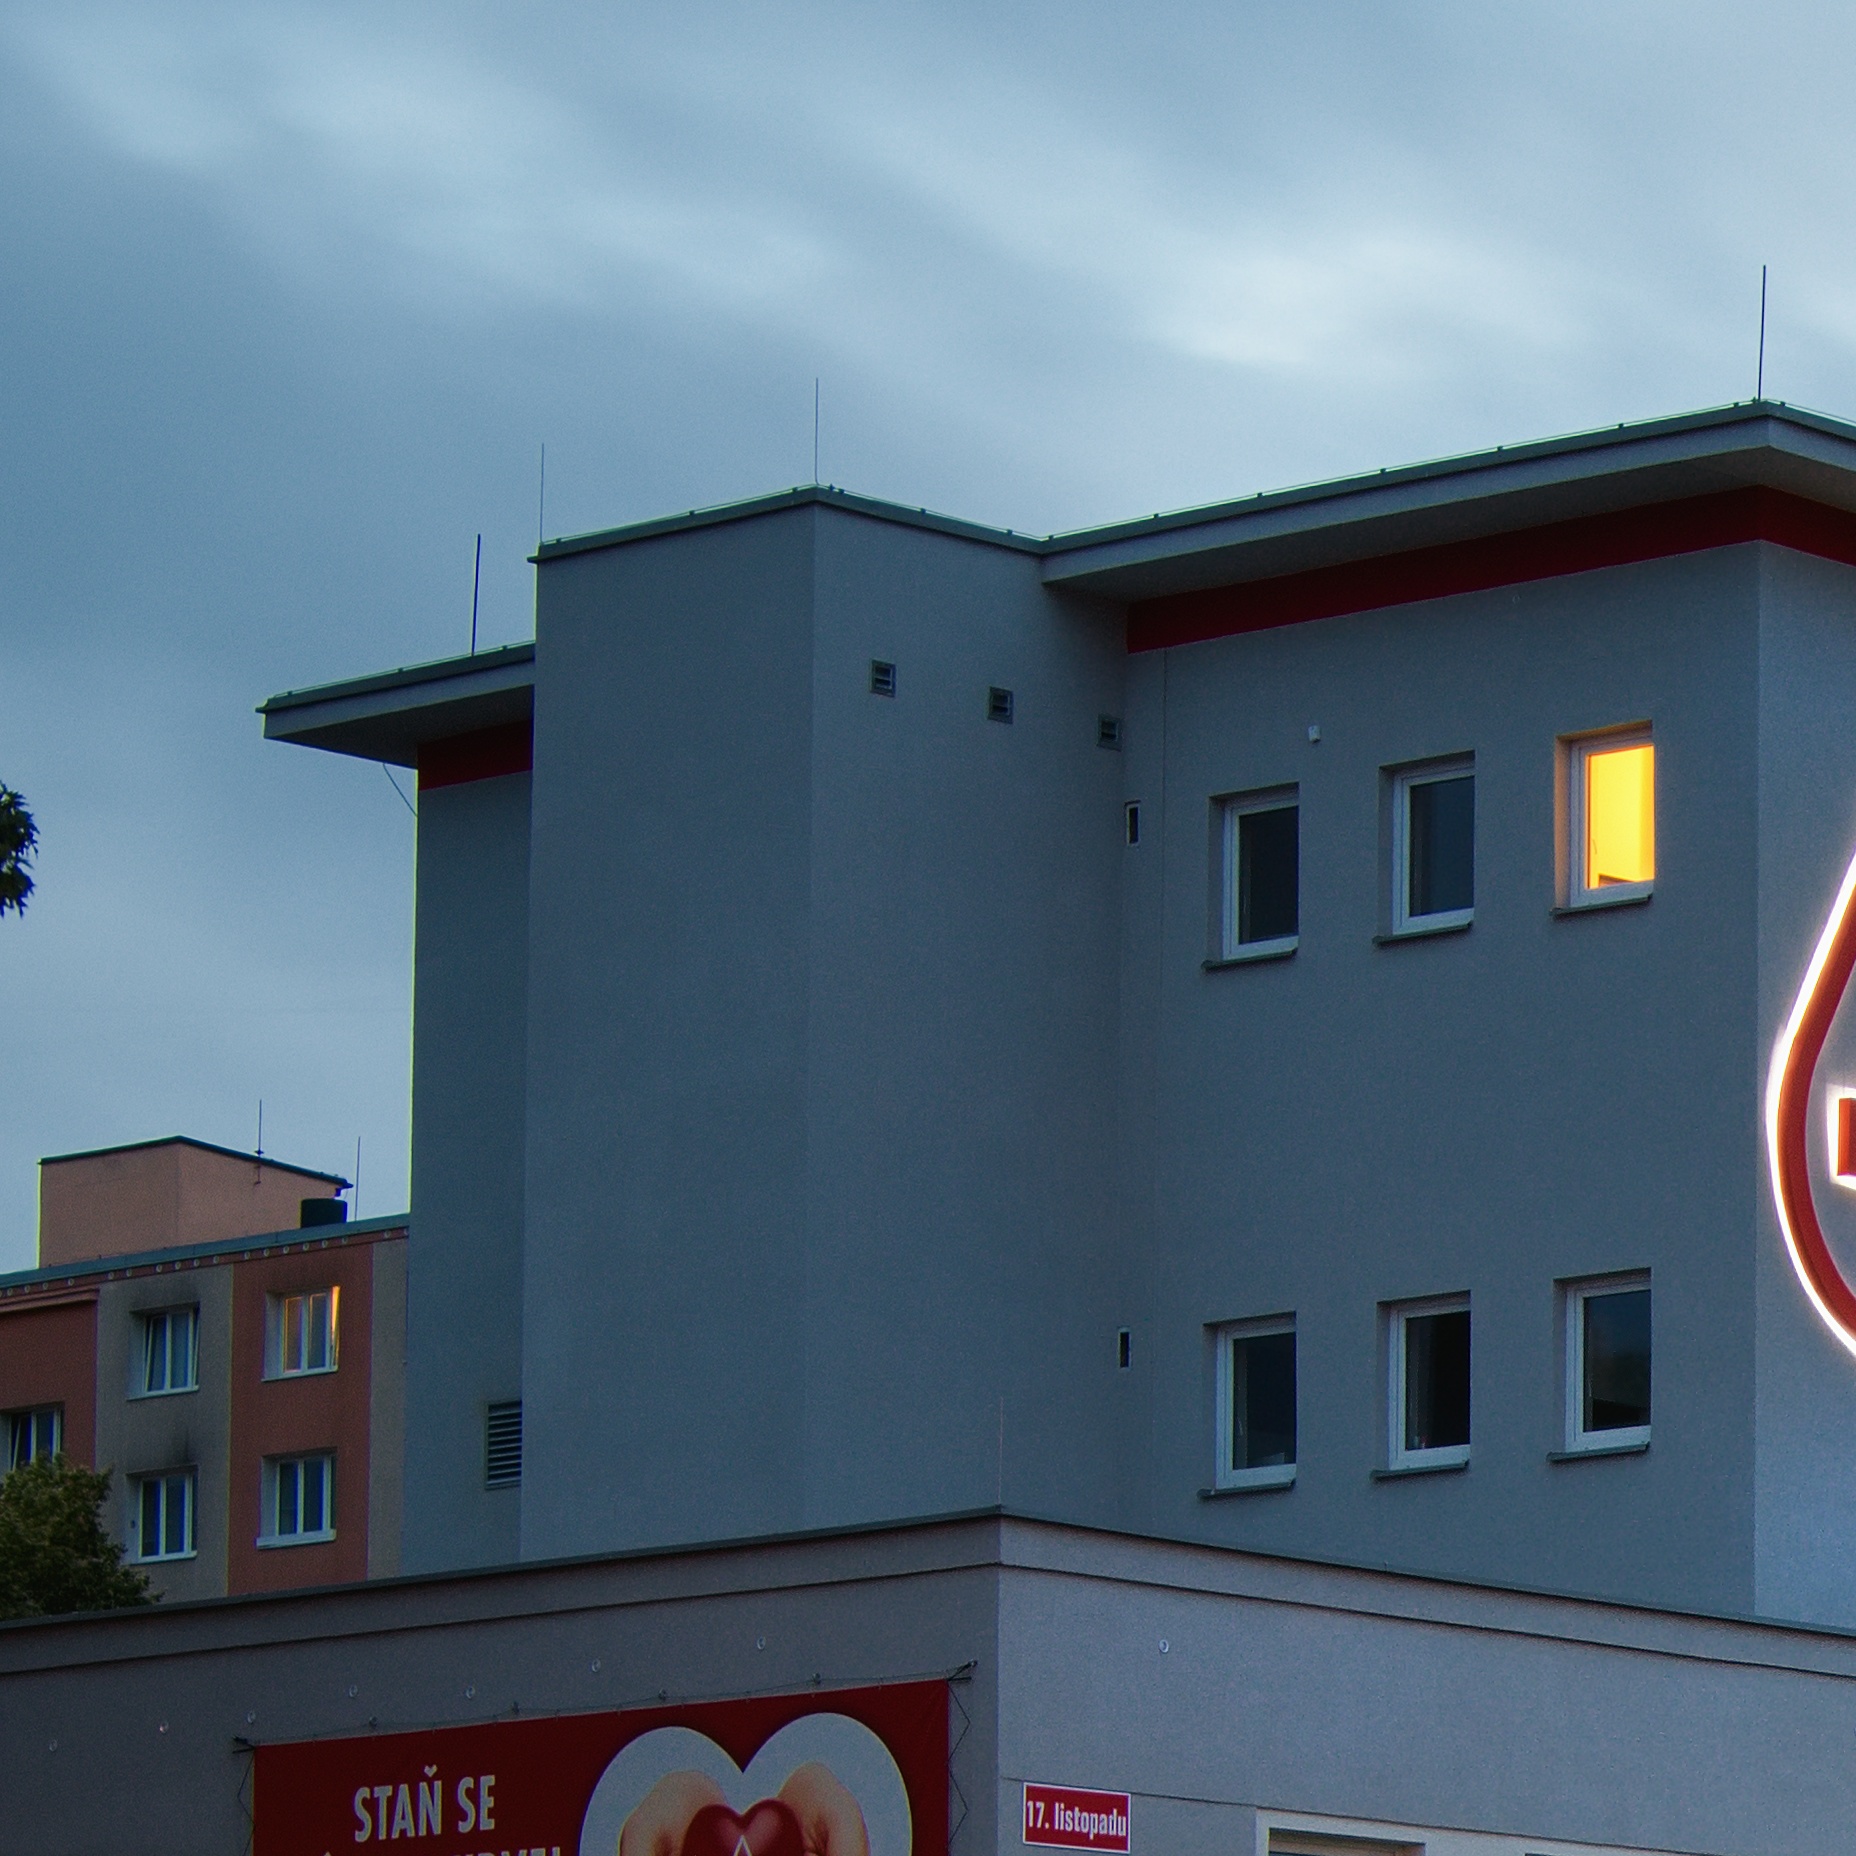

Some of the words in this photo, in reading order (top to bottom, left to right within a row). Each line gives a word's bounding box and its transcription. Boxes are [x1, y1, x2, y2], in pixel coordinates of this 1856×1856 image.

[354, 1764, 443, 1843] STAŇ
[457, 1774, 496, 1834] SE
[1027, 1800, 1050, 1830] 17.
[1054, 1802, 1126, 1840] listopadu
